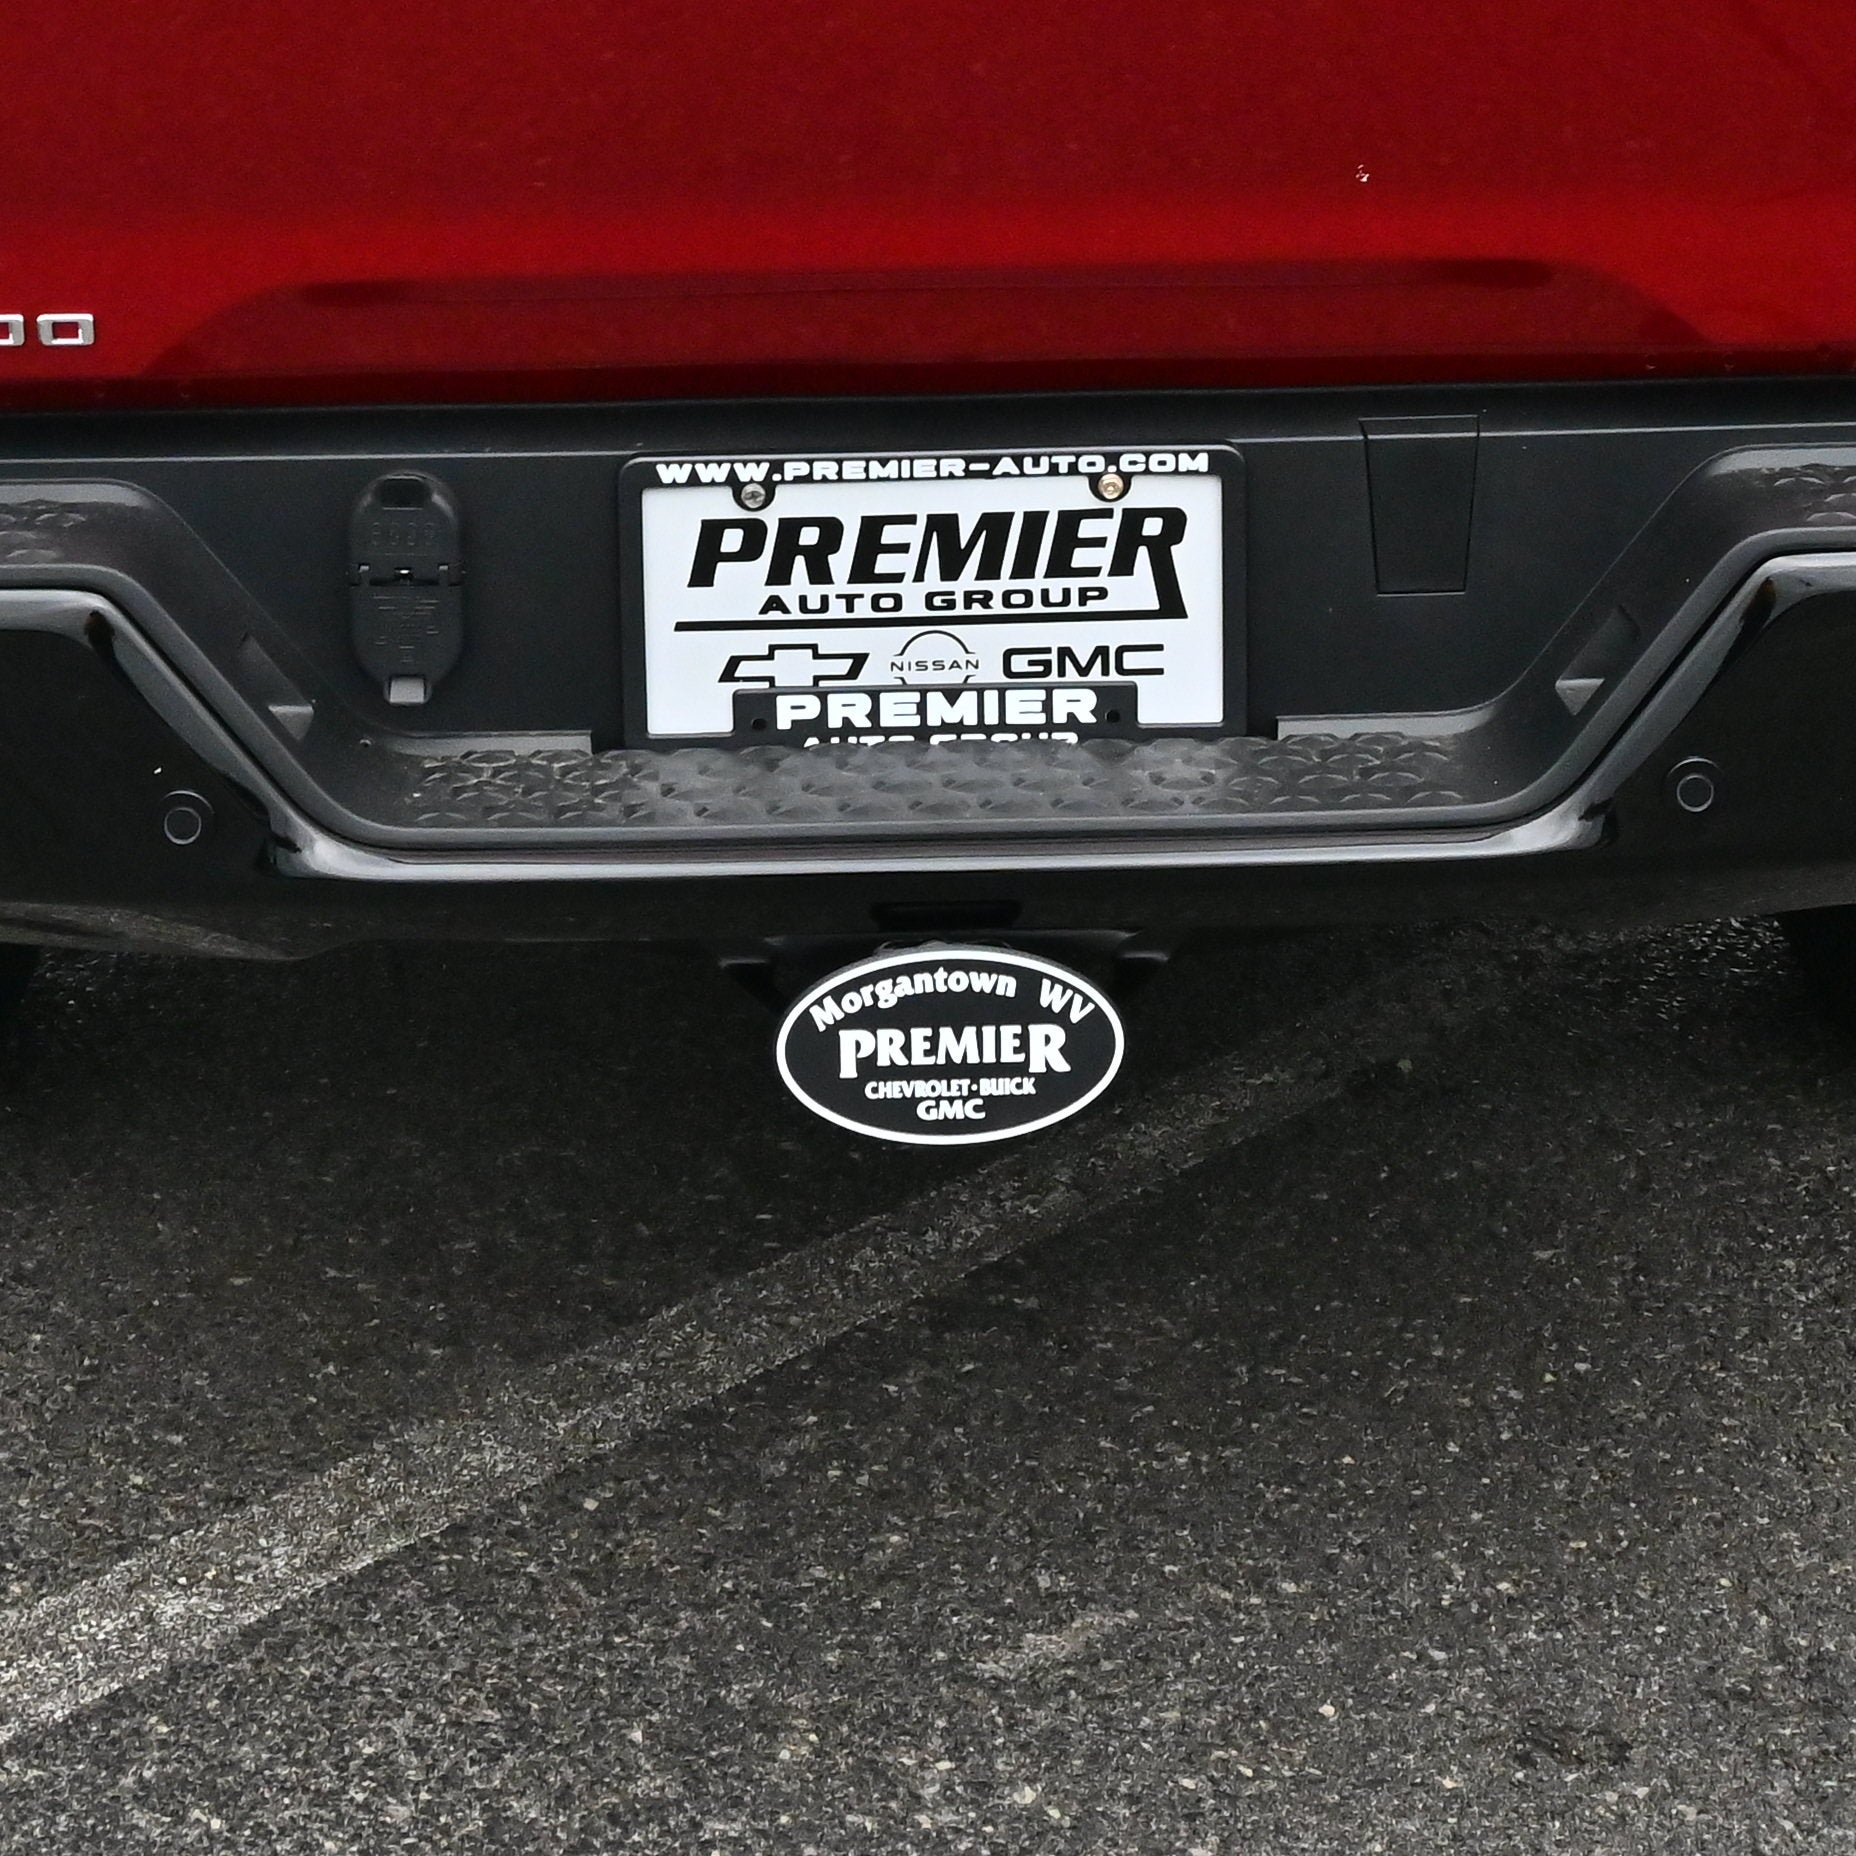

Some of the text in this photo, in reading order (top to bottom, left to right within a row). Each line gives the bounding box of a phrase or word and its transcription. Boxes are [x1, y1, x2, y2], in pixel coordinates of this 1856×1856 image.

[656, 453, 1210, 485] WWW.PREMIER-AUTO.COM
[687, 507, 1189, 619] PREMIER
[758, 587, 1109, 616] AUTO GROUP
[890, 657, 980, 674] NISSAN
[1002, 643, 1165, 680] GMC
[775, 688, 1099, 731] PREMIER
[809, 966, 1096, 1032] Morgantown WV
[838, 1023, 1072, 1080] PREMIER
[916, 1098, 987, 1121] GMC
